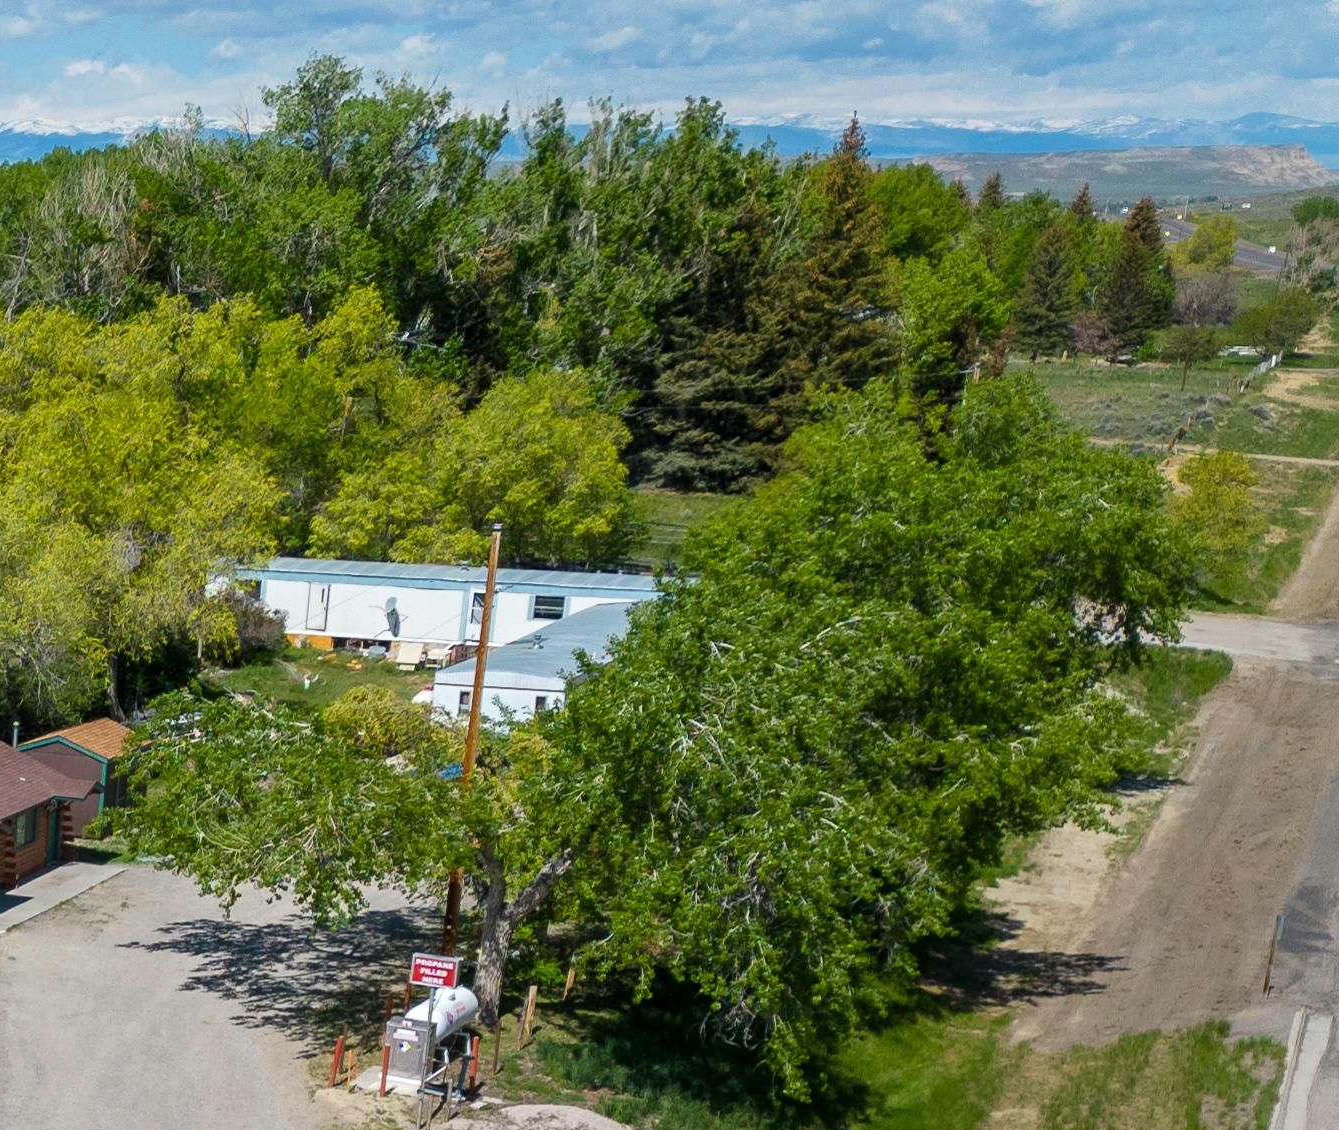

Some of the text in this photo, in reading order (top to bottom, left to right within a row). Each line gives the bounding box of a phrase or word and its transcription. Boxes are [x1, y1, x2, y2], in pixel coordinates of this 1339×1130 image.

[416, 958, 454, 970] PROPANE
[420, 967, 448, 978] FILLED
[422, 976, 444, 985] HERE
